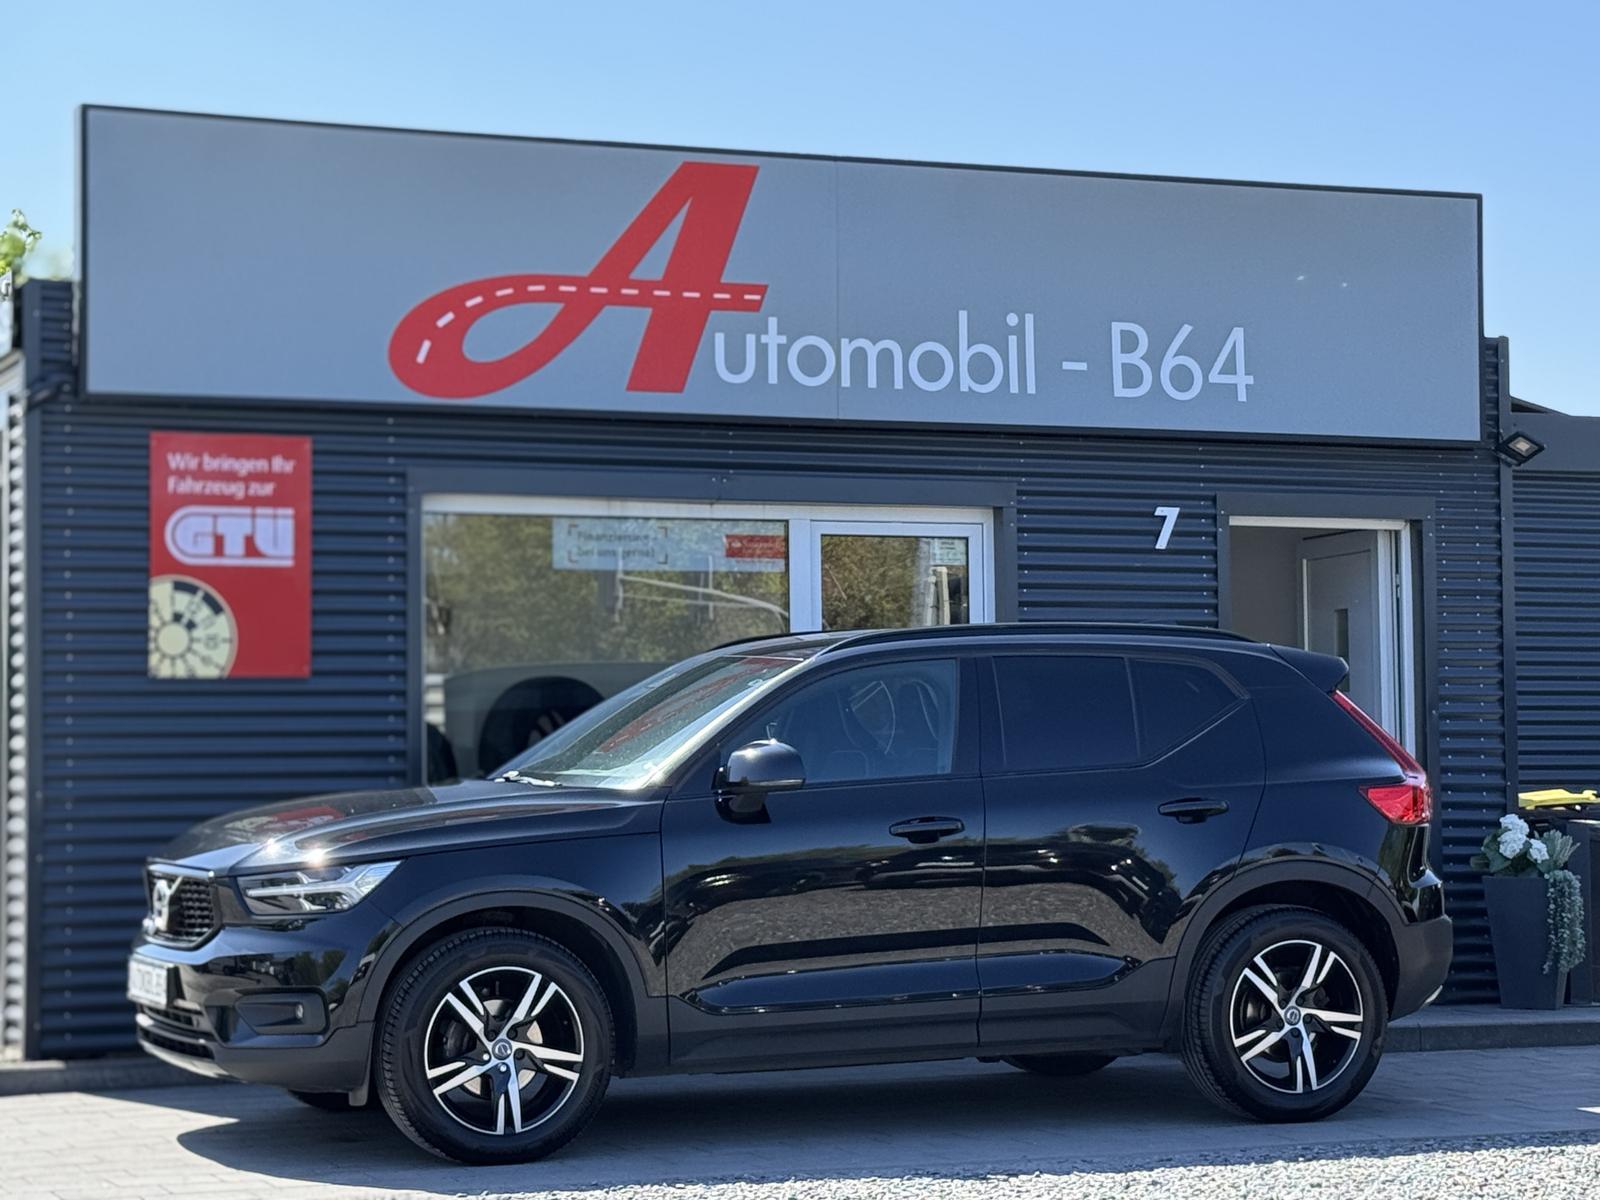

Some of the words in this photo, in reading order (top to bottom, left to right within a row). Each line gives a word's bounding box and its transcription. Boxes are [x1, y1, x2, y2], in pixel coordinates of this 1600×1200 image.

[387, 161, 1037, 399] Automobil
[1061, 360, 1088, 371] -
[1110, 321, 1254, 402] B64
[167, 453, 199, 471] Wir
[202, 453, 269, 477] bringen
[271, 455, 296, 473] Ihr
[167, 476, 245, 500] Fahrzeug
[248, 481, 276, 497] zur
[1154, 506, 1180, 550] 7
